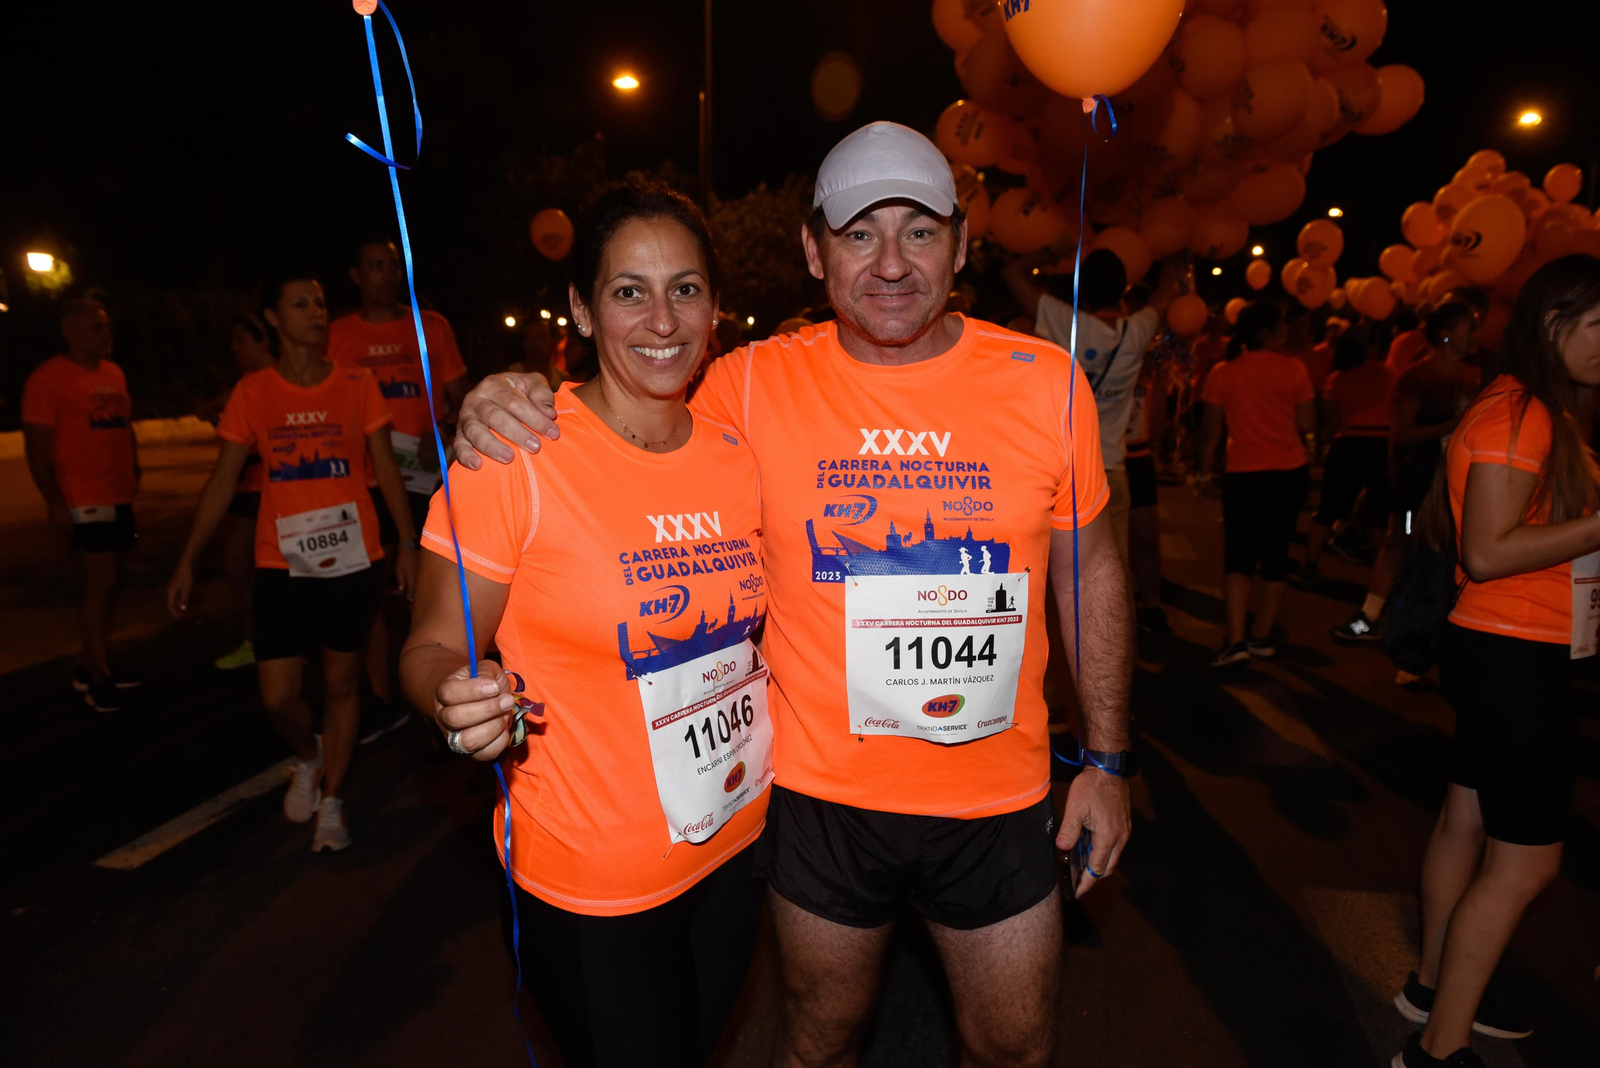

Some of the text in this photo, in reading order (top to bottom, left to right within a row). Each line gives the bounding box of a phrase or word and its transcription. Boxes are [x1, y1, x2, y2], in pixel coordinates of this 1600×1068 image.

[286, 411, 327, 426] XXXV
[858, 428, 951, 457] XXXV
[817, 459, 990, 472] CARRERA NOCTURNA
[816, 471, 825, 489] DEL
[827, 474, 992, 490] GUADALQUIVIR
[646, 511, 722, 543] XXXV
[297, 530, 348, 553] 10884
[619, 538, 751, 565] CARRERA NOCTURNA
[623, 566, 634, 586] DEL
[636, 551, 758, 582] GUADALQUIVIR
[815, 571, 841, 581] 2023
[875, 619, 904, 627] CARRERA
[905, 618, 940, 627] NOCTURNA
[941, 618, 952, 626] DEL
[953, 618, 996, 626] GUADALQUIVIR
[885, 634, 997, 670] 11044
[886, 674, 994, 686] CARLOS J. MARTÍN VÁZQUEZ
[654, 717, 670, 728] XXXV
[670, 707, 693, 721] CARRERA
[684, 694, 754, 759] 11046
[977, 715, 1007, 729] Cruzcampo
[697, 758, 723, 775] ENCARNI
